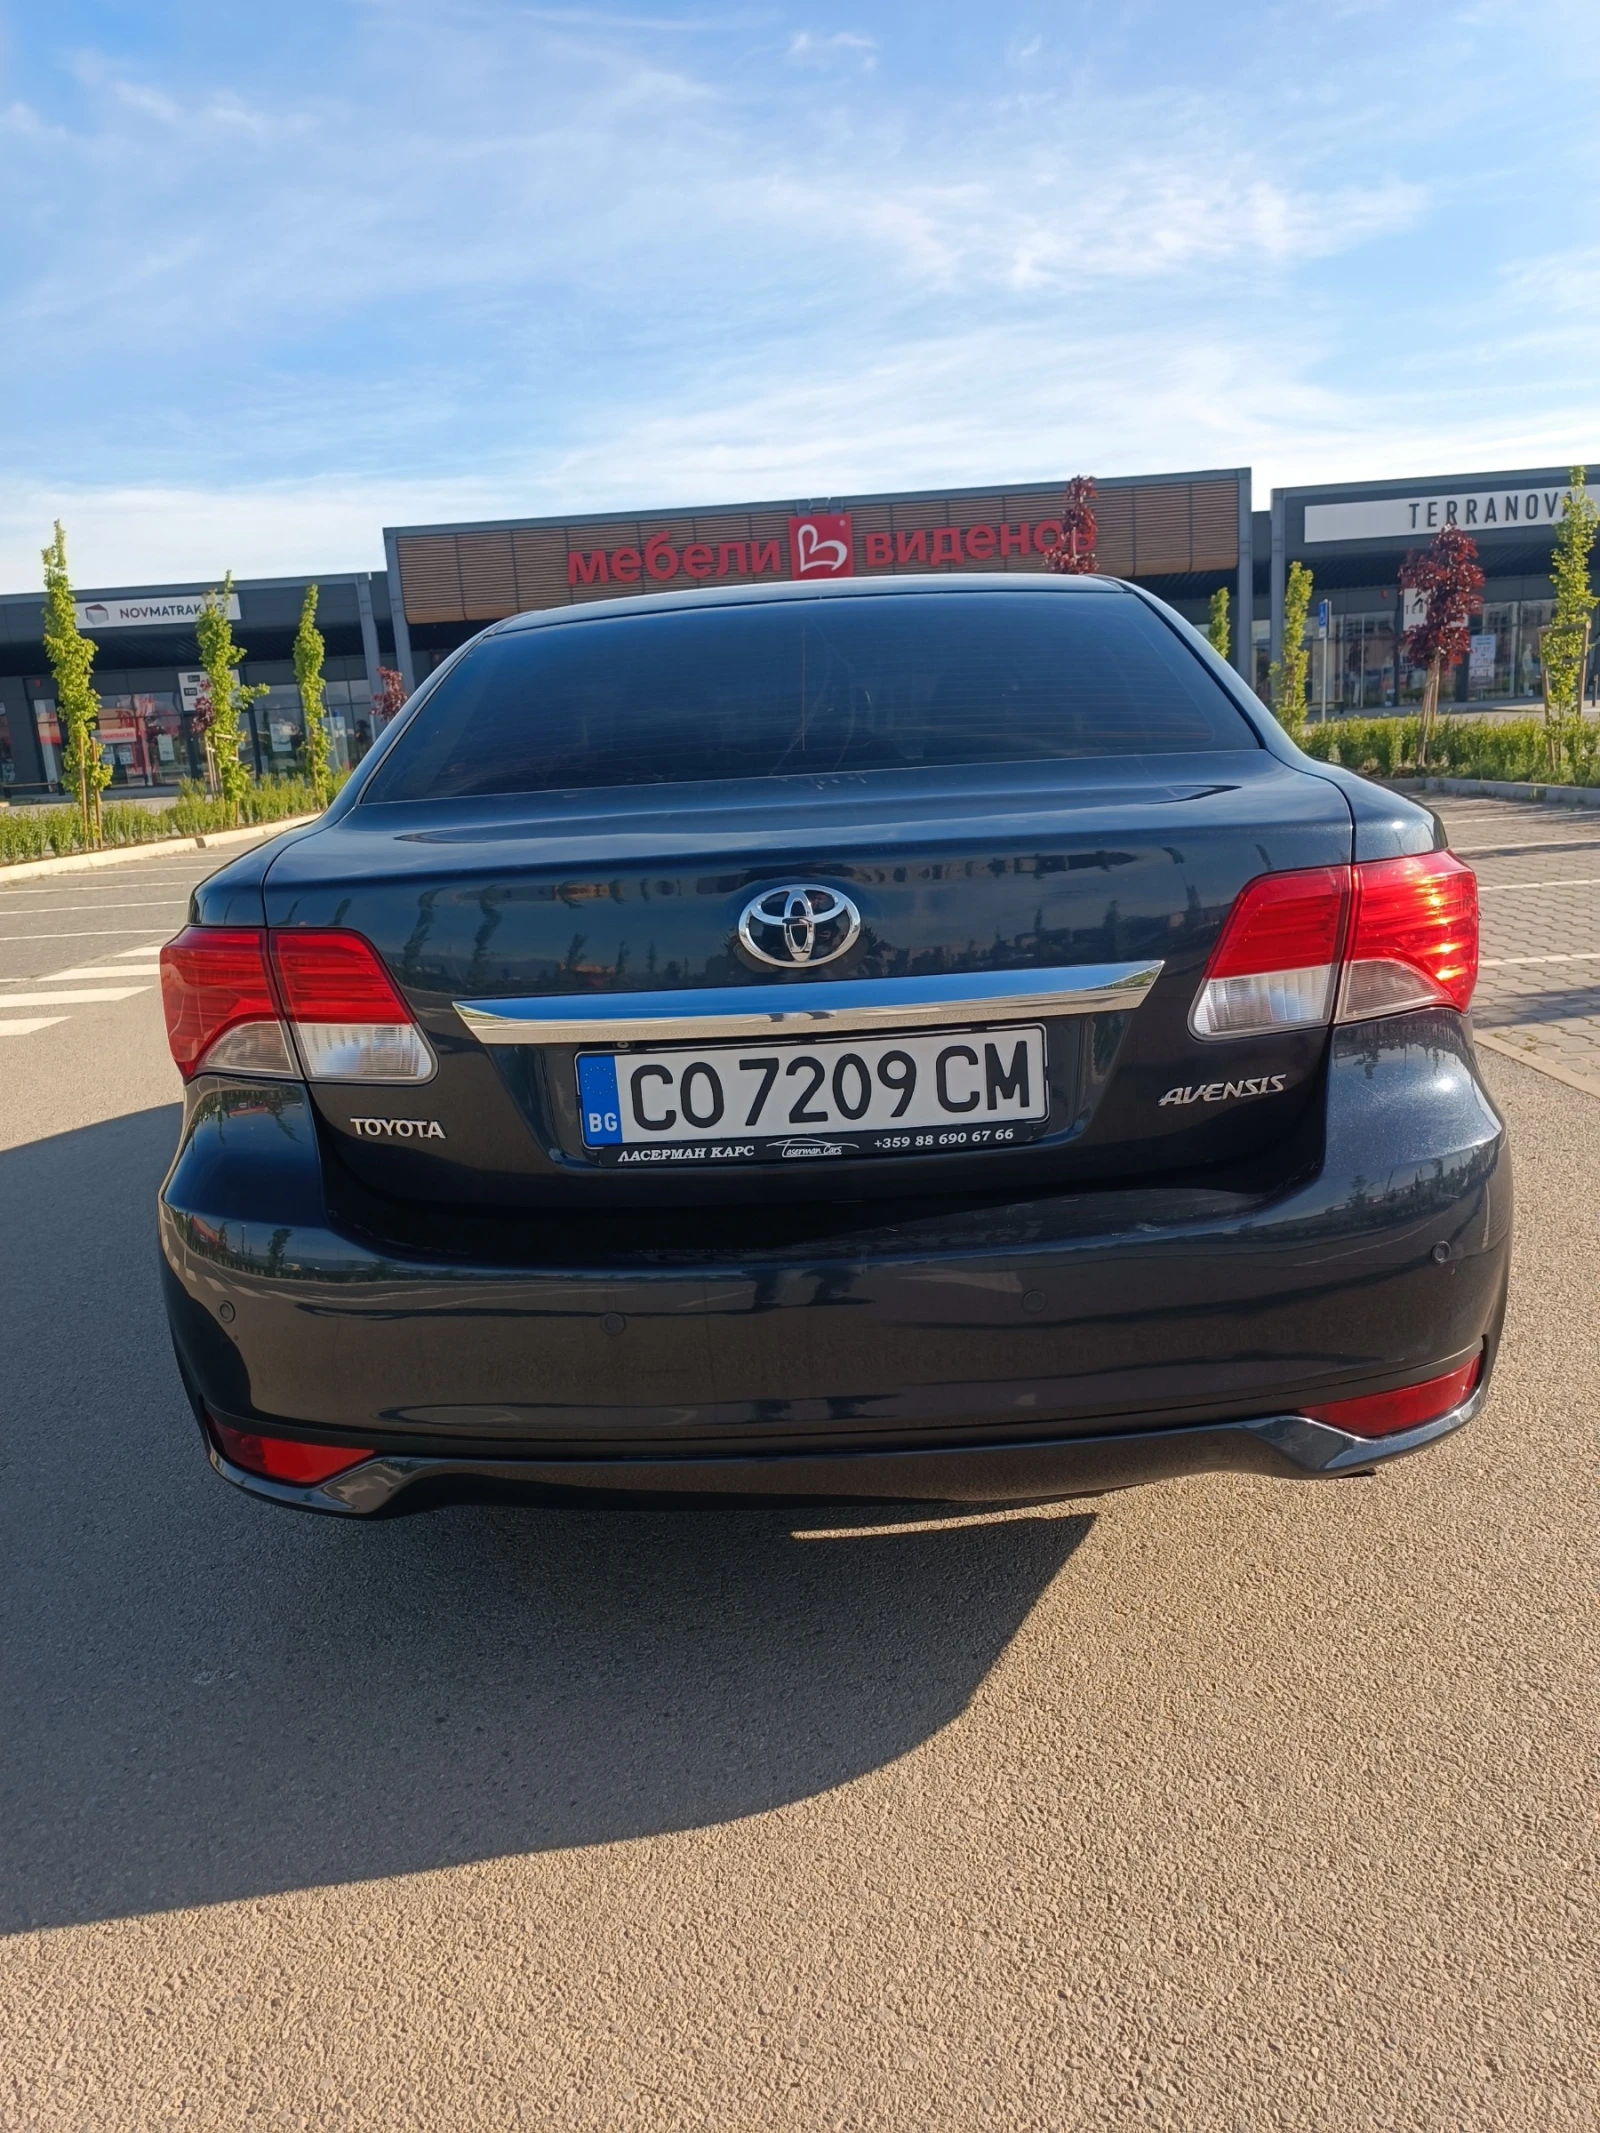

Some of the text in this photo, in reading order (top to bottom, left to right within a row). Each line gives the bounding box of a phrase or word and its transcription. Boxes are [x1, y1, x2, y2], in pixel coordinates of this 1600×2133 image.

[567, 519, 1096, 586] мебели виденов
[739, 1050, 918, 1127] 7209
[935, 1040, 1031, 1113] CM
[1158, 1073, 1287, 1106] AVENSIS
[350, 1118, 446, 1139] TOYOTA
[588, 1112, 618, 1133] BG
[874, 1128, 1014, 1149] +359 88 690 67 66
[617, 1145, 755, 1162] ЛАСЕРМАН КАРС
[823, 1144, 843, 1155] Cars
